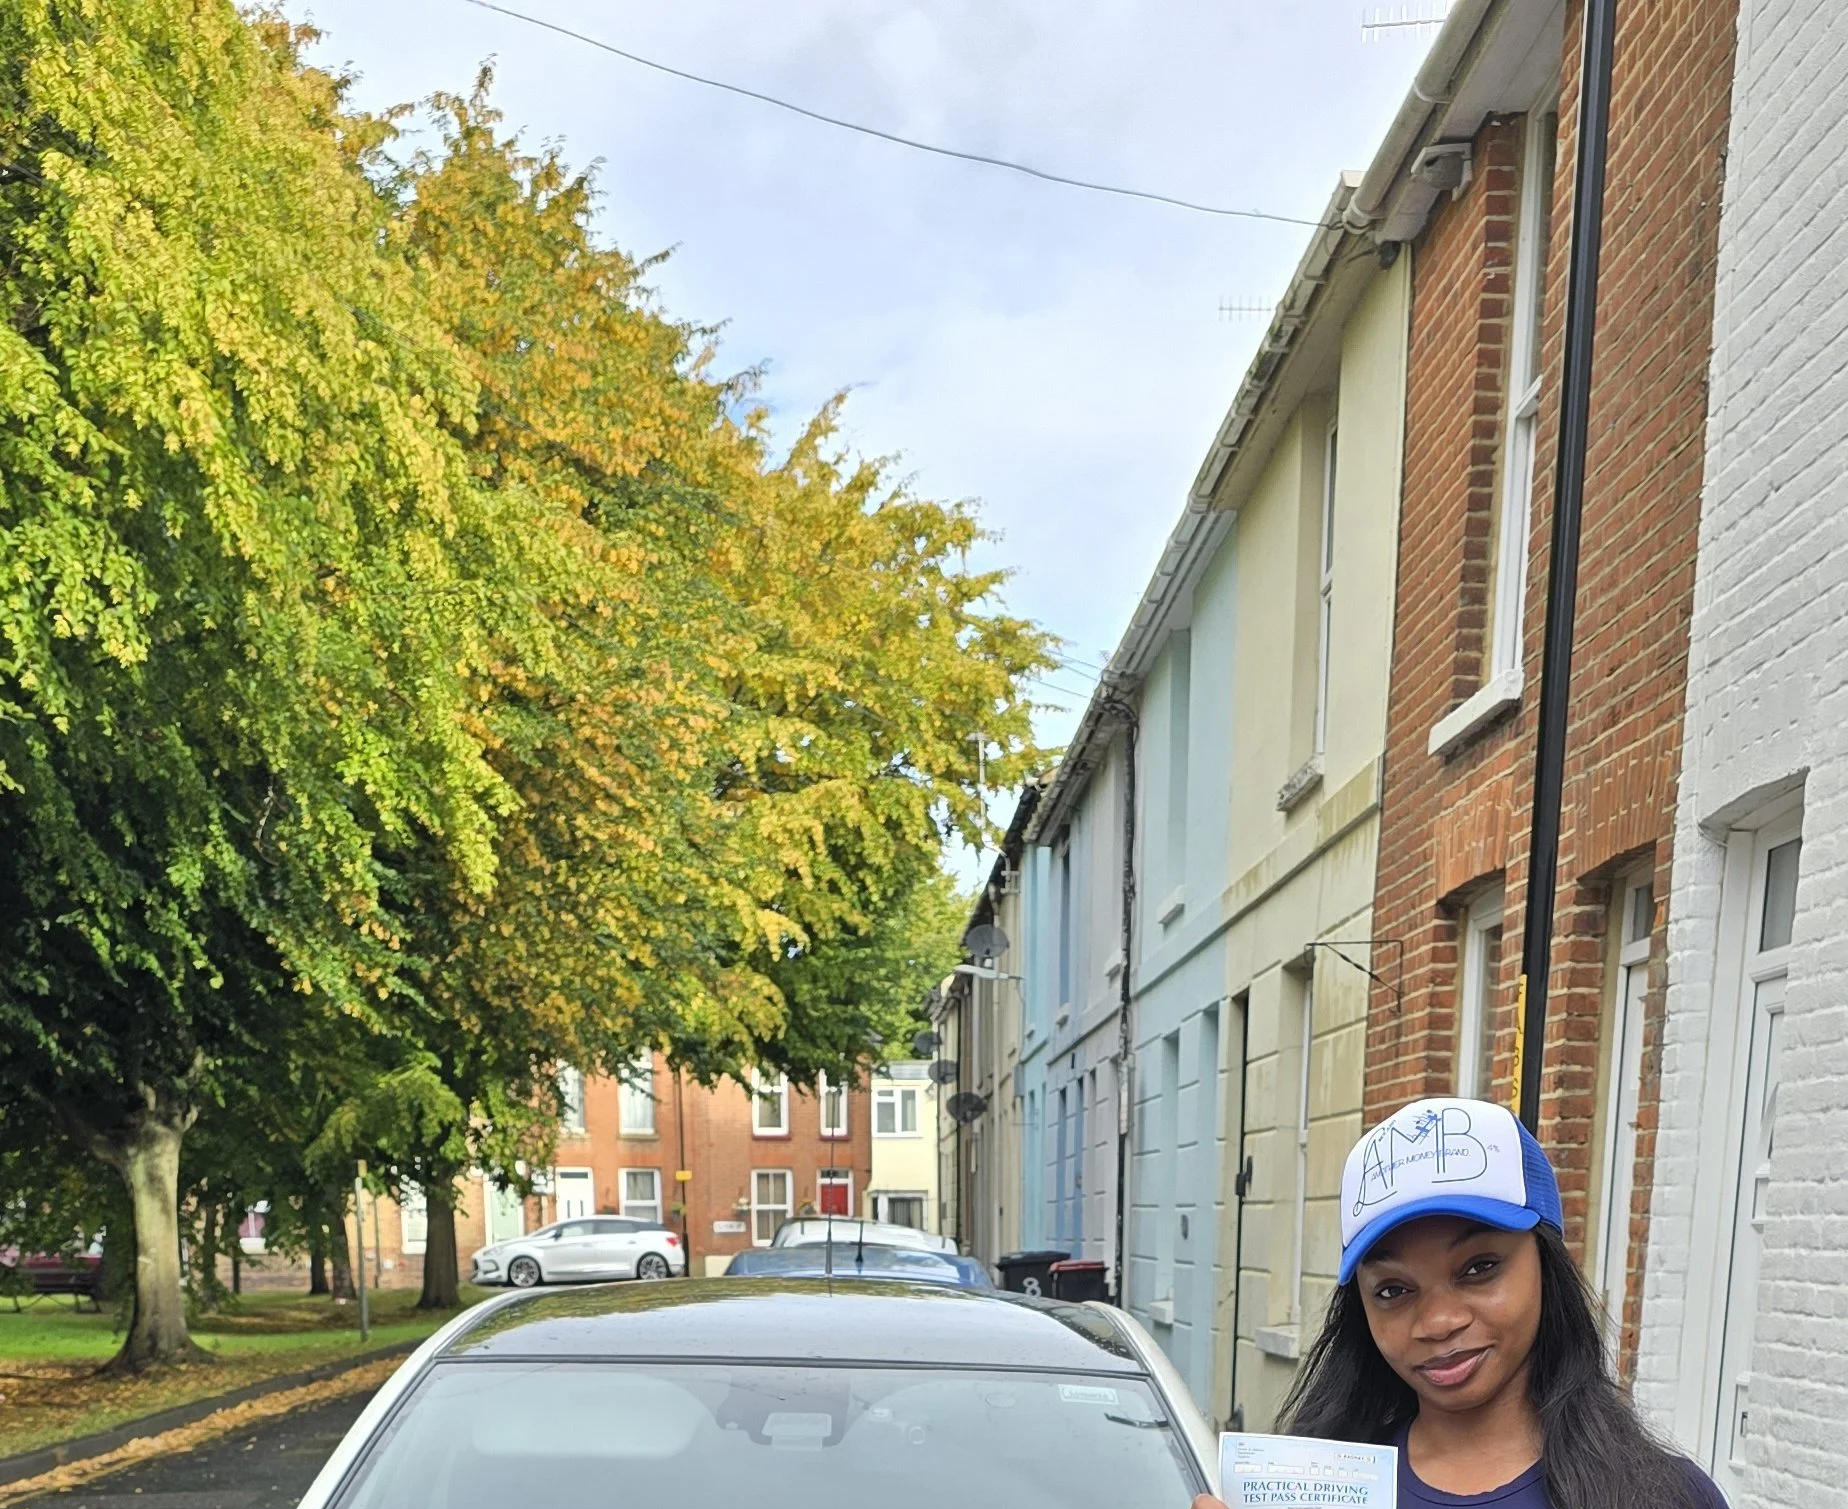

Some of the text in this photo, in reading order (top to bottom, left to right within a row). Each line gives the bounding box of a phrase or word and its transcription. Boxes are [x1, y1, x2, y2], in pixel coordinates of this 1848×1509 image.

[1022, 1277, 1042, 1298] 8
[1243, 1481, 1369, 1496] PRACTICAL DRIVING
[1244, 1492, 1368, 1505] TEST PASS CERTIFICATE
